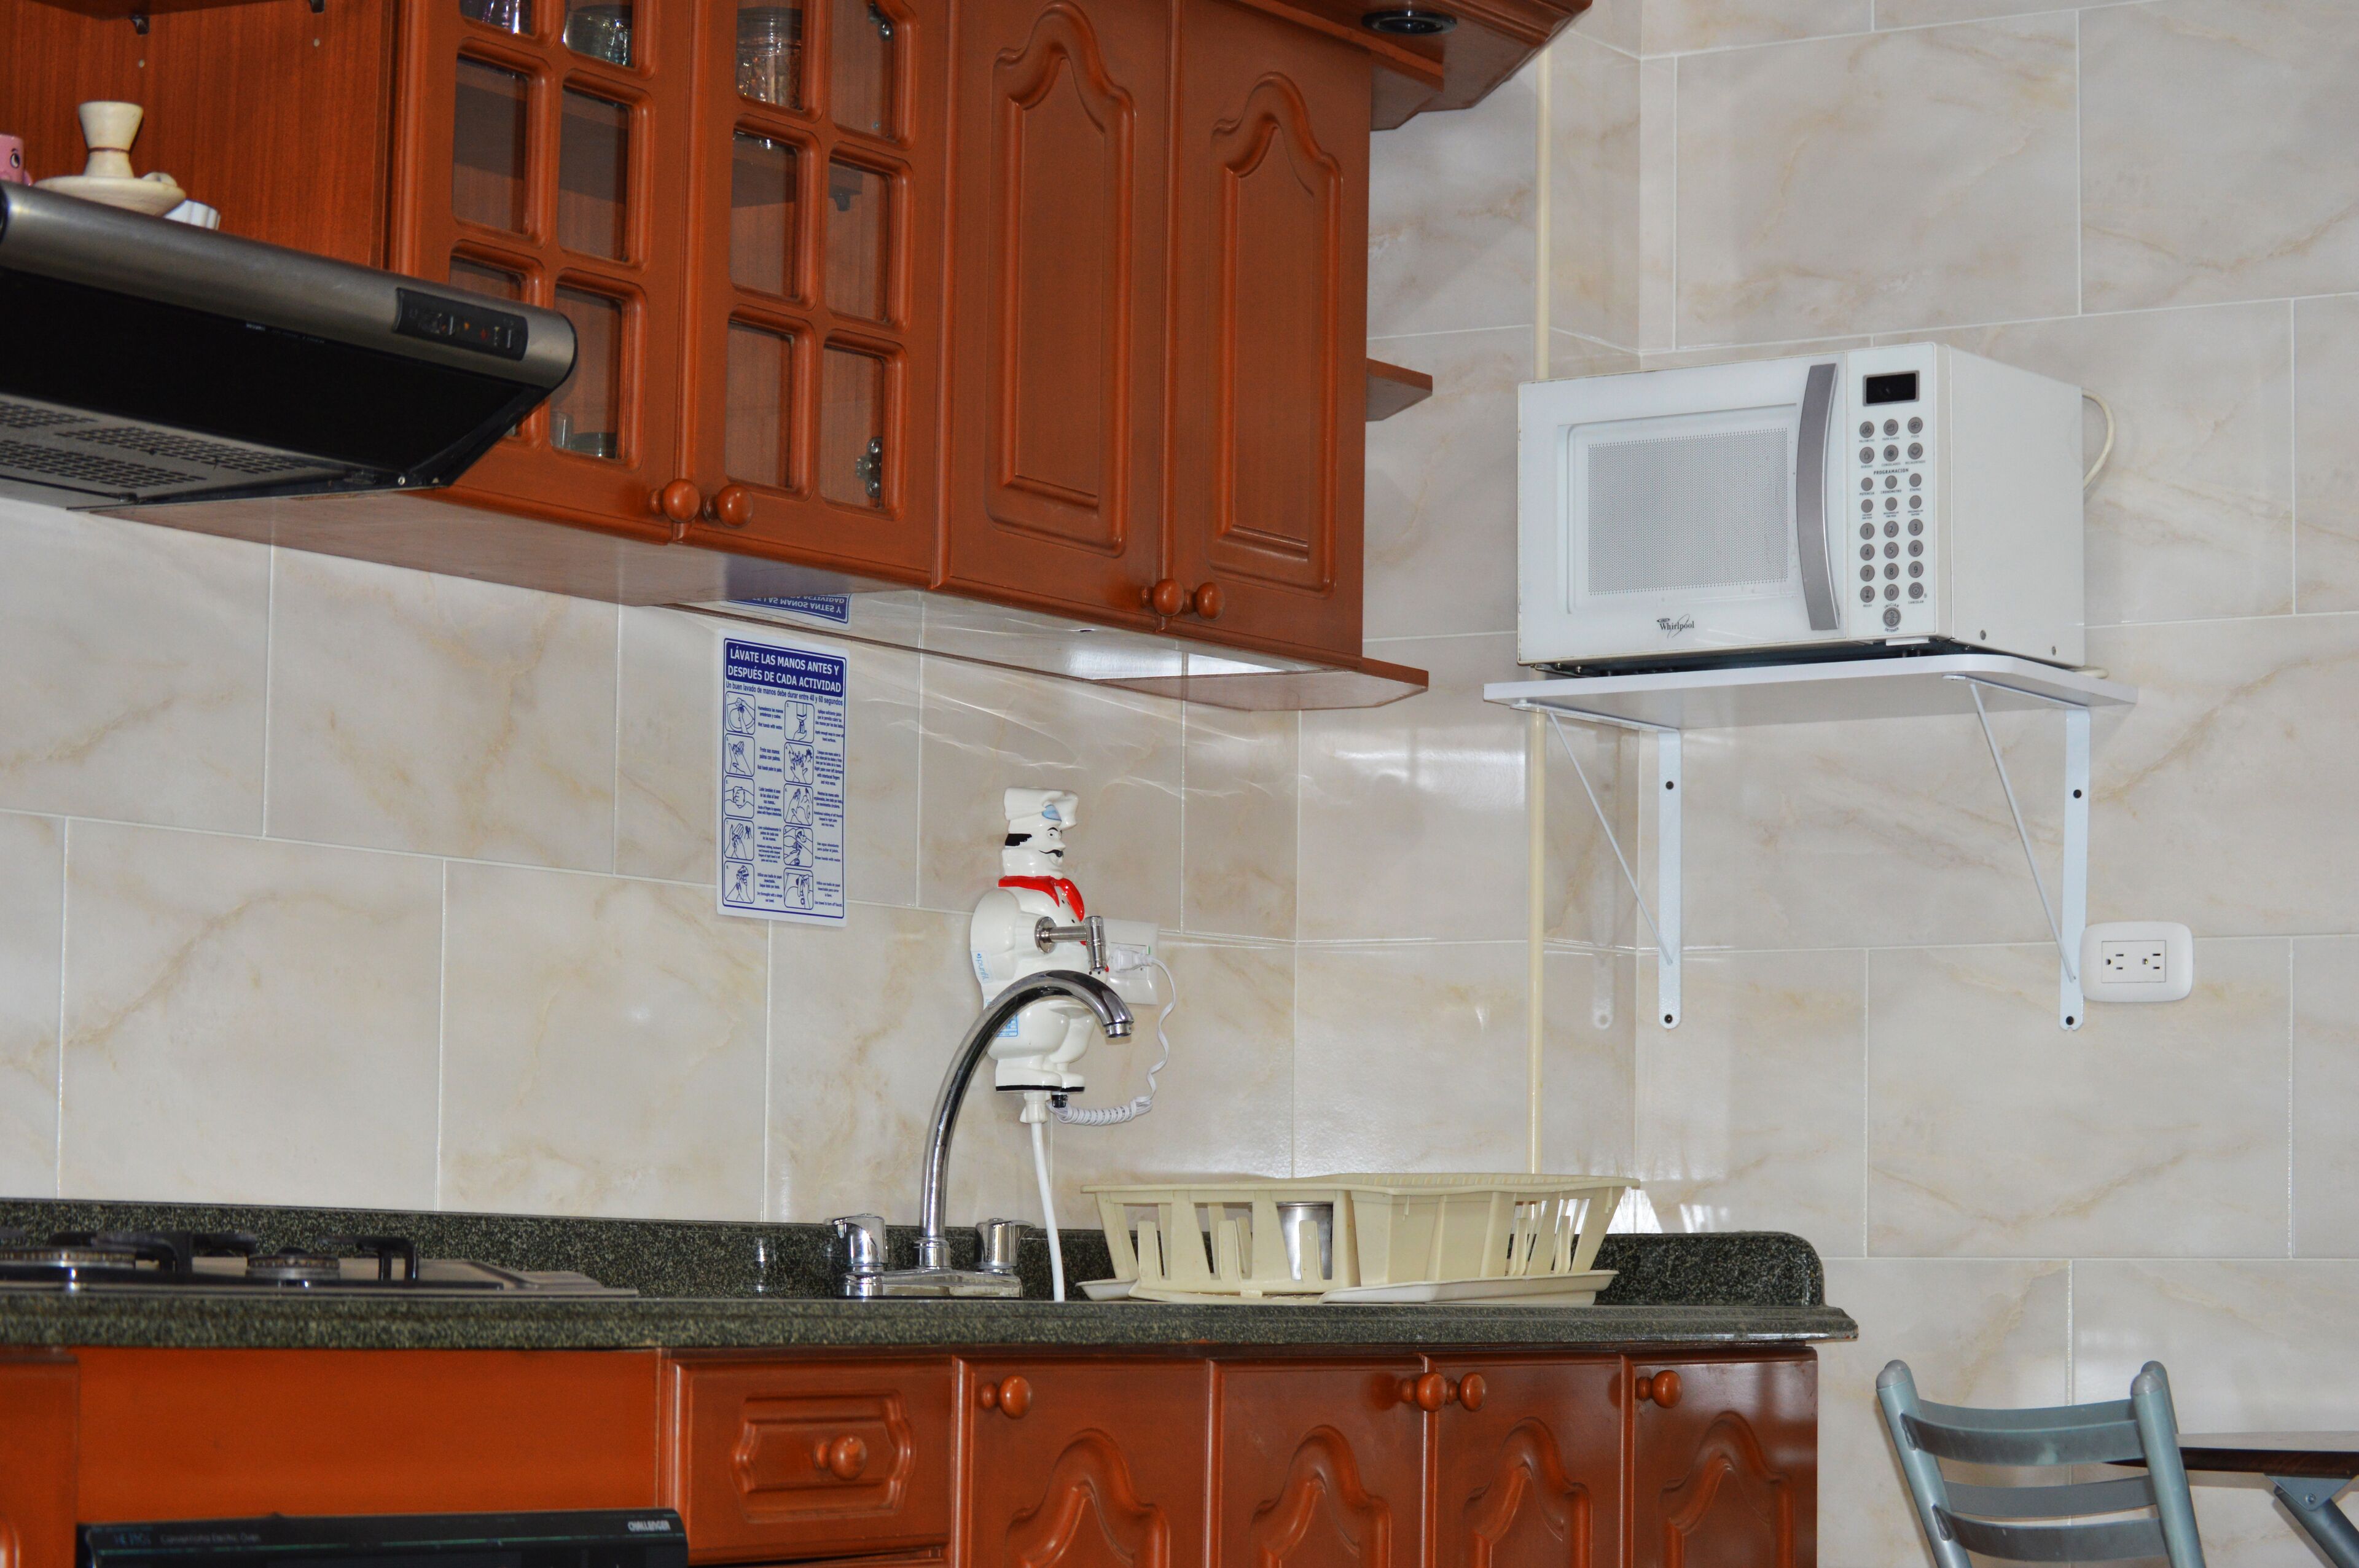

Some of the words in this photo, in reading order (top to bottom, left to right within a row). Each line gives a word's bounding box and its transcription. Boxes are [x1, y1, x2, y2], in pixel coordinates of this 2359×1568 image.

[1660, 620, 1694, 631] Whirlpool
[730, 646, 759, 663] LÁVATE
[761, 653, 776, 666] LAS
[777, 656, 806, 670] MANOS
[807, 661, 832, 674] ANTES
[834, 665, 839, 676] Y
[728, 665, 762, 681] DESPUÉS
[764, 671, 774, 682] DE
[777, 673, 797, 686] CADA
[799, 677, 841, 693] ACTIVIDAD
[743, 684, 756, 692] lavado
[763, 687, 776, 696] manos
[788, 690, 798, 699] durar
[824, 698, 843, 706] segundos
[627, 1520, 671, 1532] CHALLENGER
